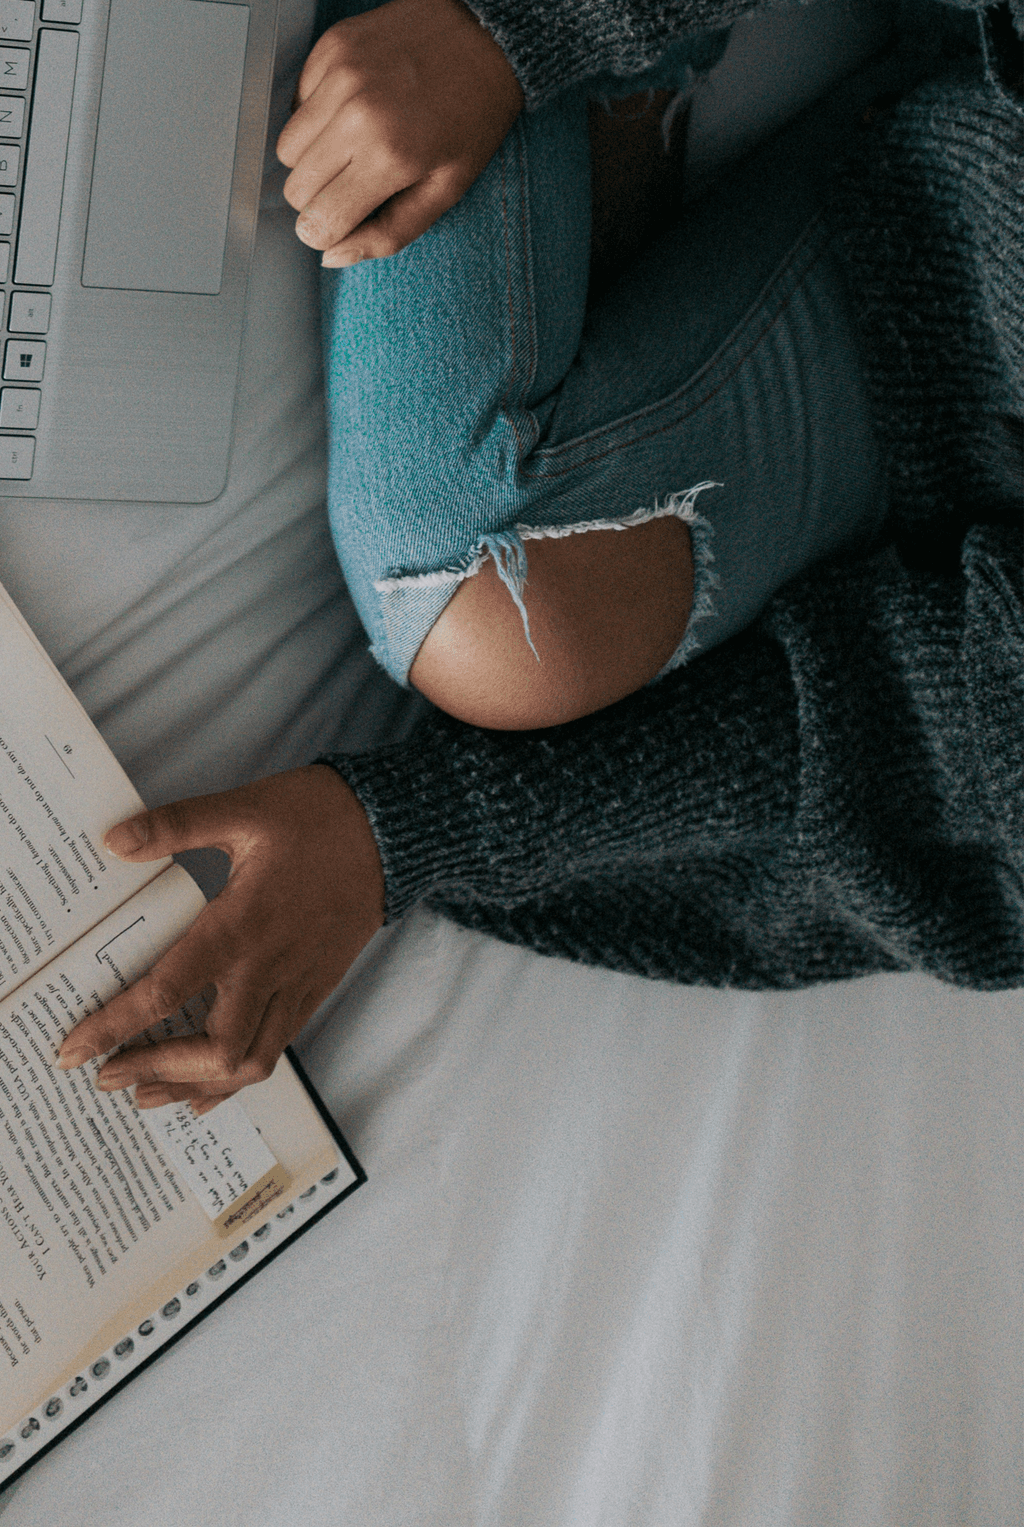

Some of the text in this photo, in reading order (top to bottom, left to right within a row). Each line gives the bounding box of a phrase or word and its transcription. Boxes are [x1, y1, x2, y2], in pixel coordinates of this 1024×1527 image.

[2, 60, 18, 76] M
[10, 450, 18, 464] ctrl
[62, 743, 73, 755] 49
[182, 1142, 198, 1165] say
[198, 1142, 211, 1161] say
[197, 1170, 208, 1183] we
[212, 1163, 224, 1178] we
[206, 1186, 225, 1212] What
[224, 1181, 239, 1201] How
